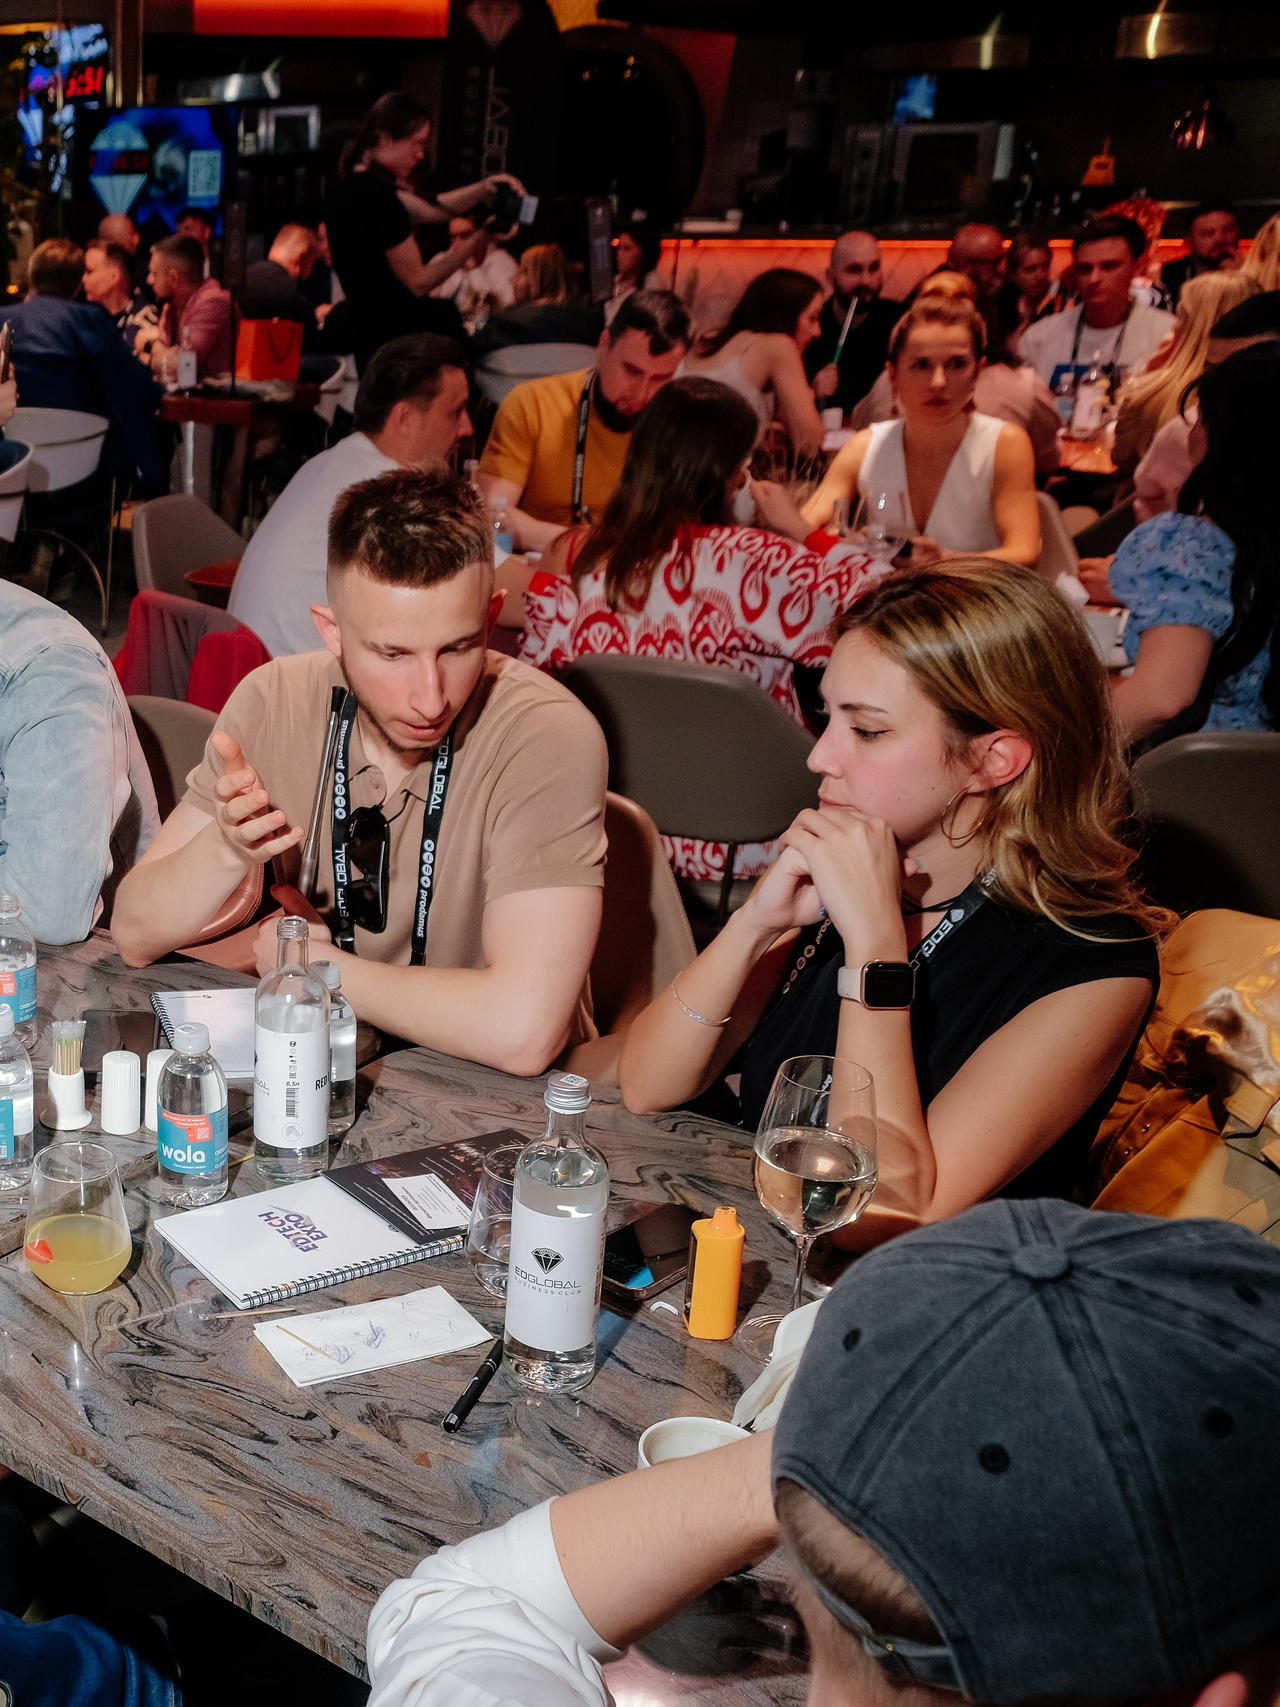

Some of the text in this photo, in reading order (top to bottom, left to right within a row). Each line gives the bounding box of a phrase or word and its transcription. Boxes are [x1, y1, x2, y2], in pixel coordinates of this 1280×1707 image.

[416, 889, 427, 938] prodamus
[162, 1142, 206, 1163] wola
[258, 1211, 318, 1252] EDTECH
[285, 1214, 328, 1241] EXPO
[515, 1266, 582, 1289] EDGLOBAL
[515, 1276, 555, 1295] BUSINESS
